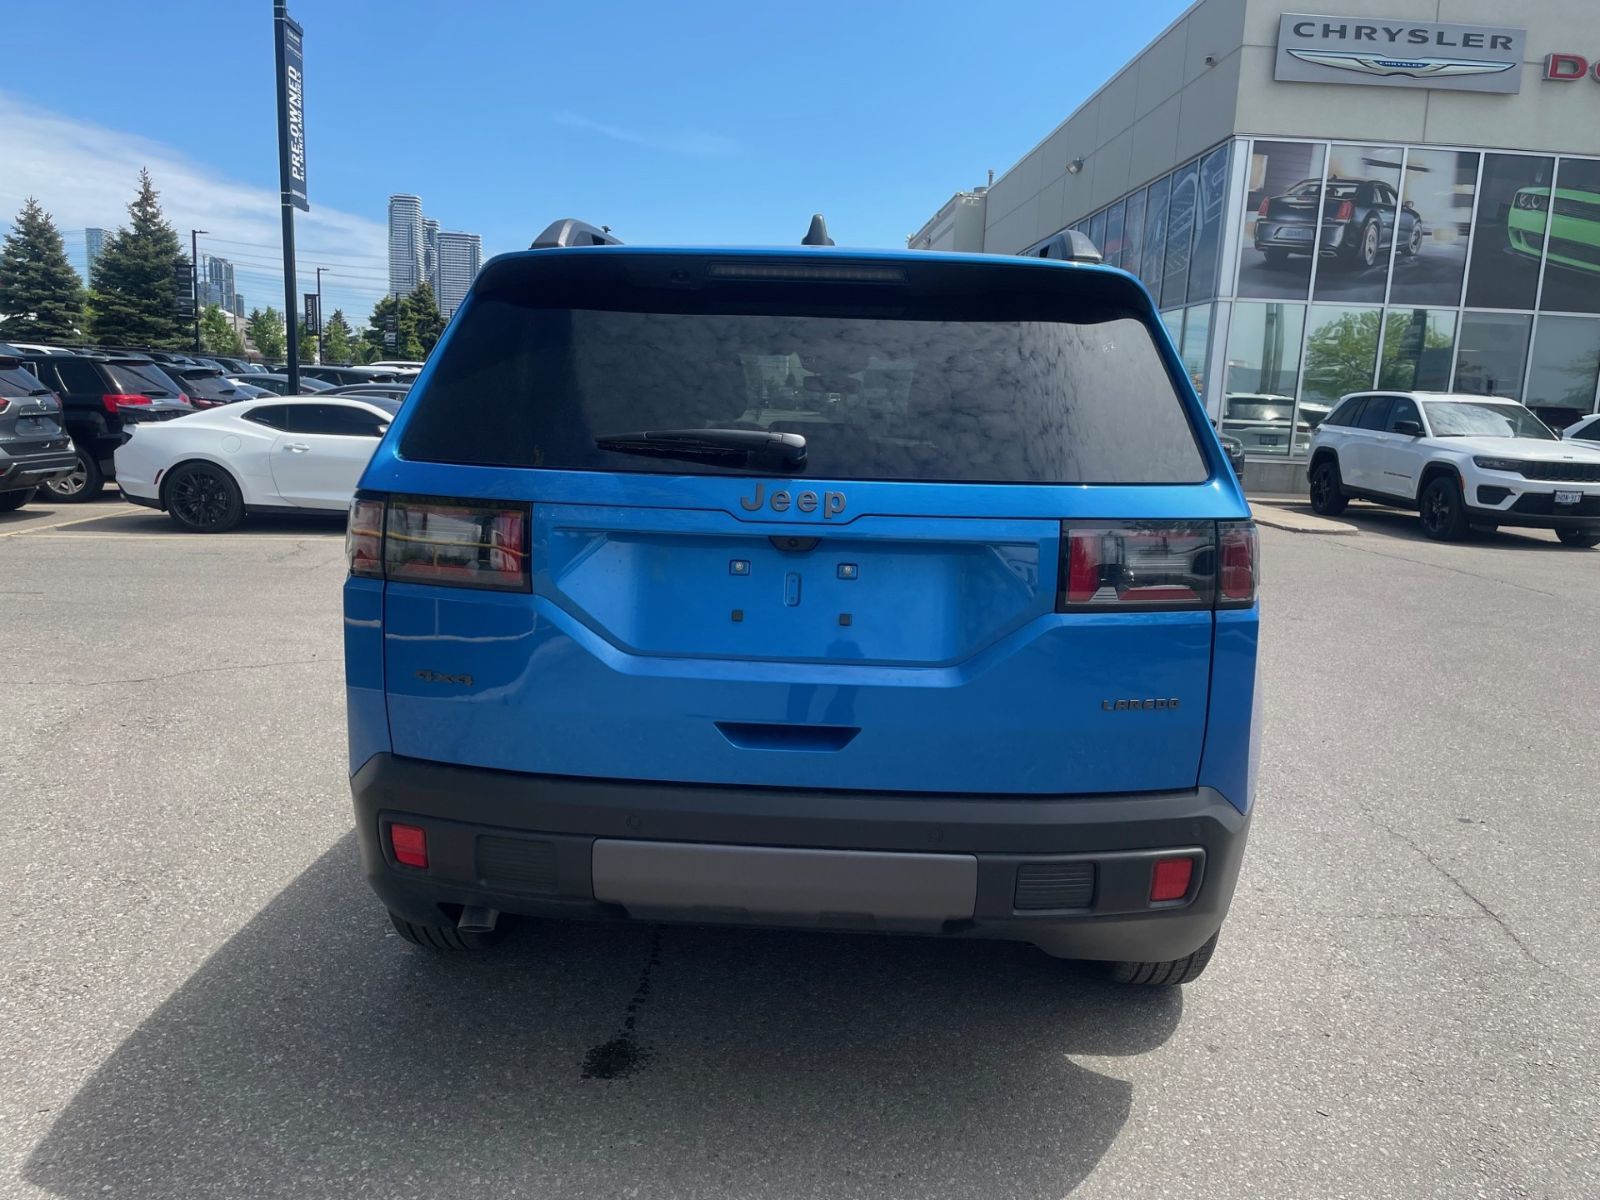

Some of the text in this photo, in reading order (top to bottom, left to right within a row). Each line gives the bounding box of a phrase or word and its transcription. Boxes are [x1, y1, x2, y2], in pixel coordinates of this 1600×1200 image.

[1293, 22, 1513, 50] CHRYSLER
[1542, 52, 1600, 81] D
[288, 65, 301, 180] PRE-OWNED
[740, 482, 847, 519] Jeep
[1102, 698, 1179, 711] LAREDO
